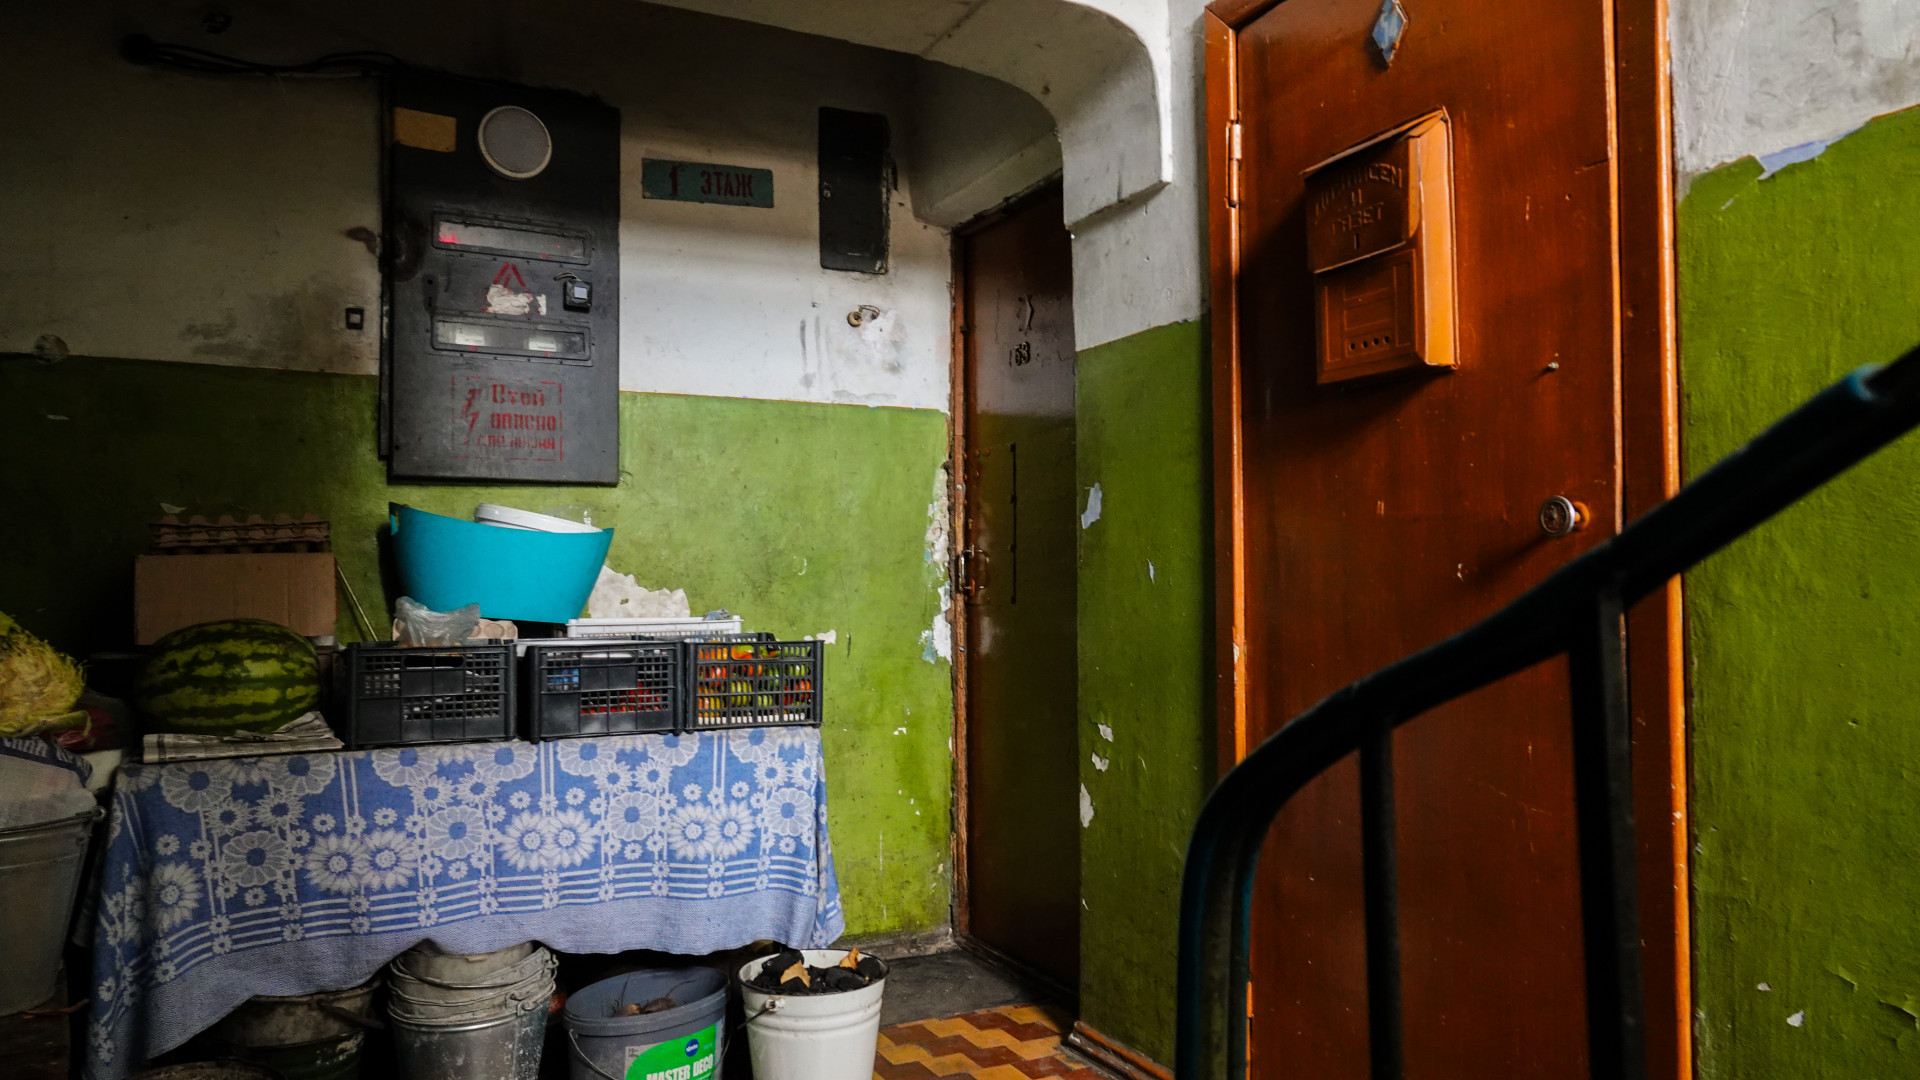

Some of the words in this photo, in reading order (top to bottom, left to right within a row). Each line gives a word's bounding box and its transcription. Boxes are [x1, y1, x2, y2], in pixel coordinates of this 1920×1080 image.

[668, 165, 679, 197] 1
[700, 169, 754, 198] ЭТАЖ
[693, 1053, 714, 1077] DECO
